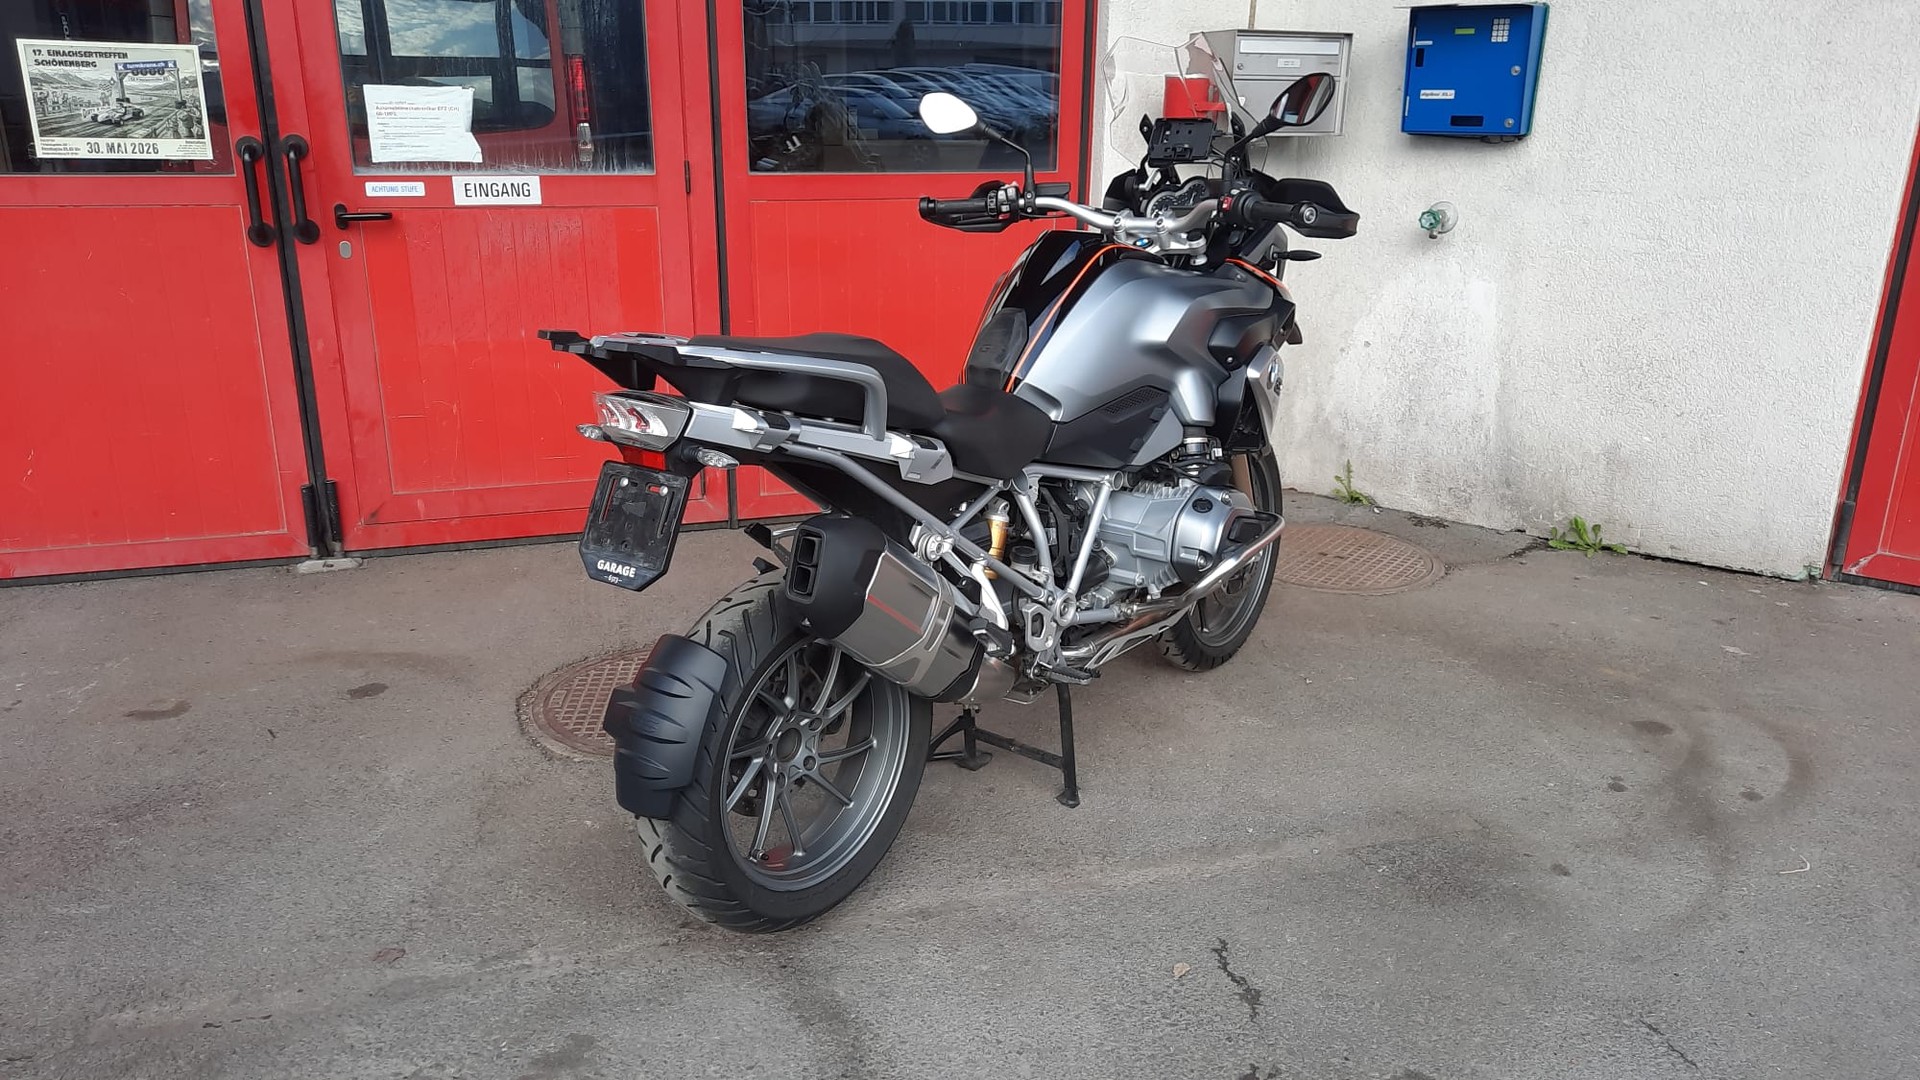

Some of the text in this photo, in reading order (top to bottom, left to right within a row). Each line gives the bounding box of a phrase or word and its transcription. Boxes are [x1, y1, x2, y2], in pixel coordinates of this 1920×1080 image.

[32, 49, 128, 59] 17. EINACHSERTREFFEN
[34, 58, 97, 68] SCHÖNENBERG
[86, 141, 159, 155] 30. MAI 2026
[371, 185, 419, 193] ACHTUNG STUFE
[464, 182, 531, 198] EINGANG
[597, 559, 636, 578] GARAGE
